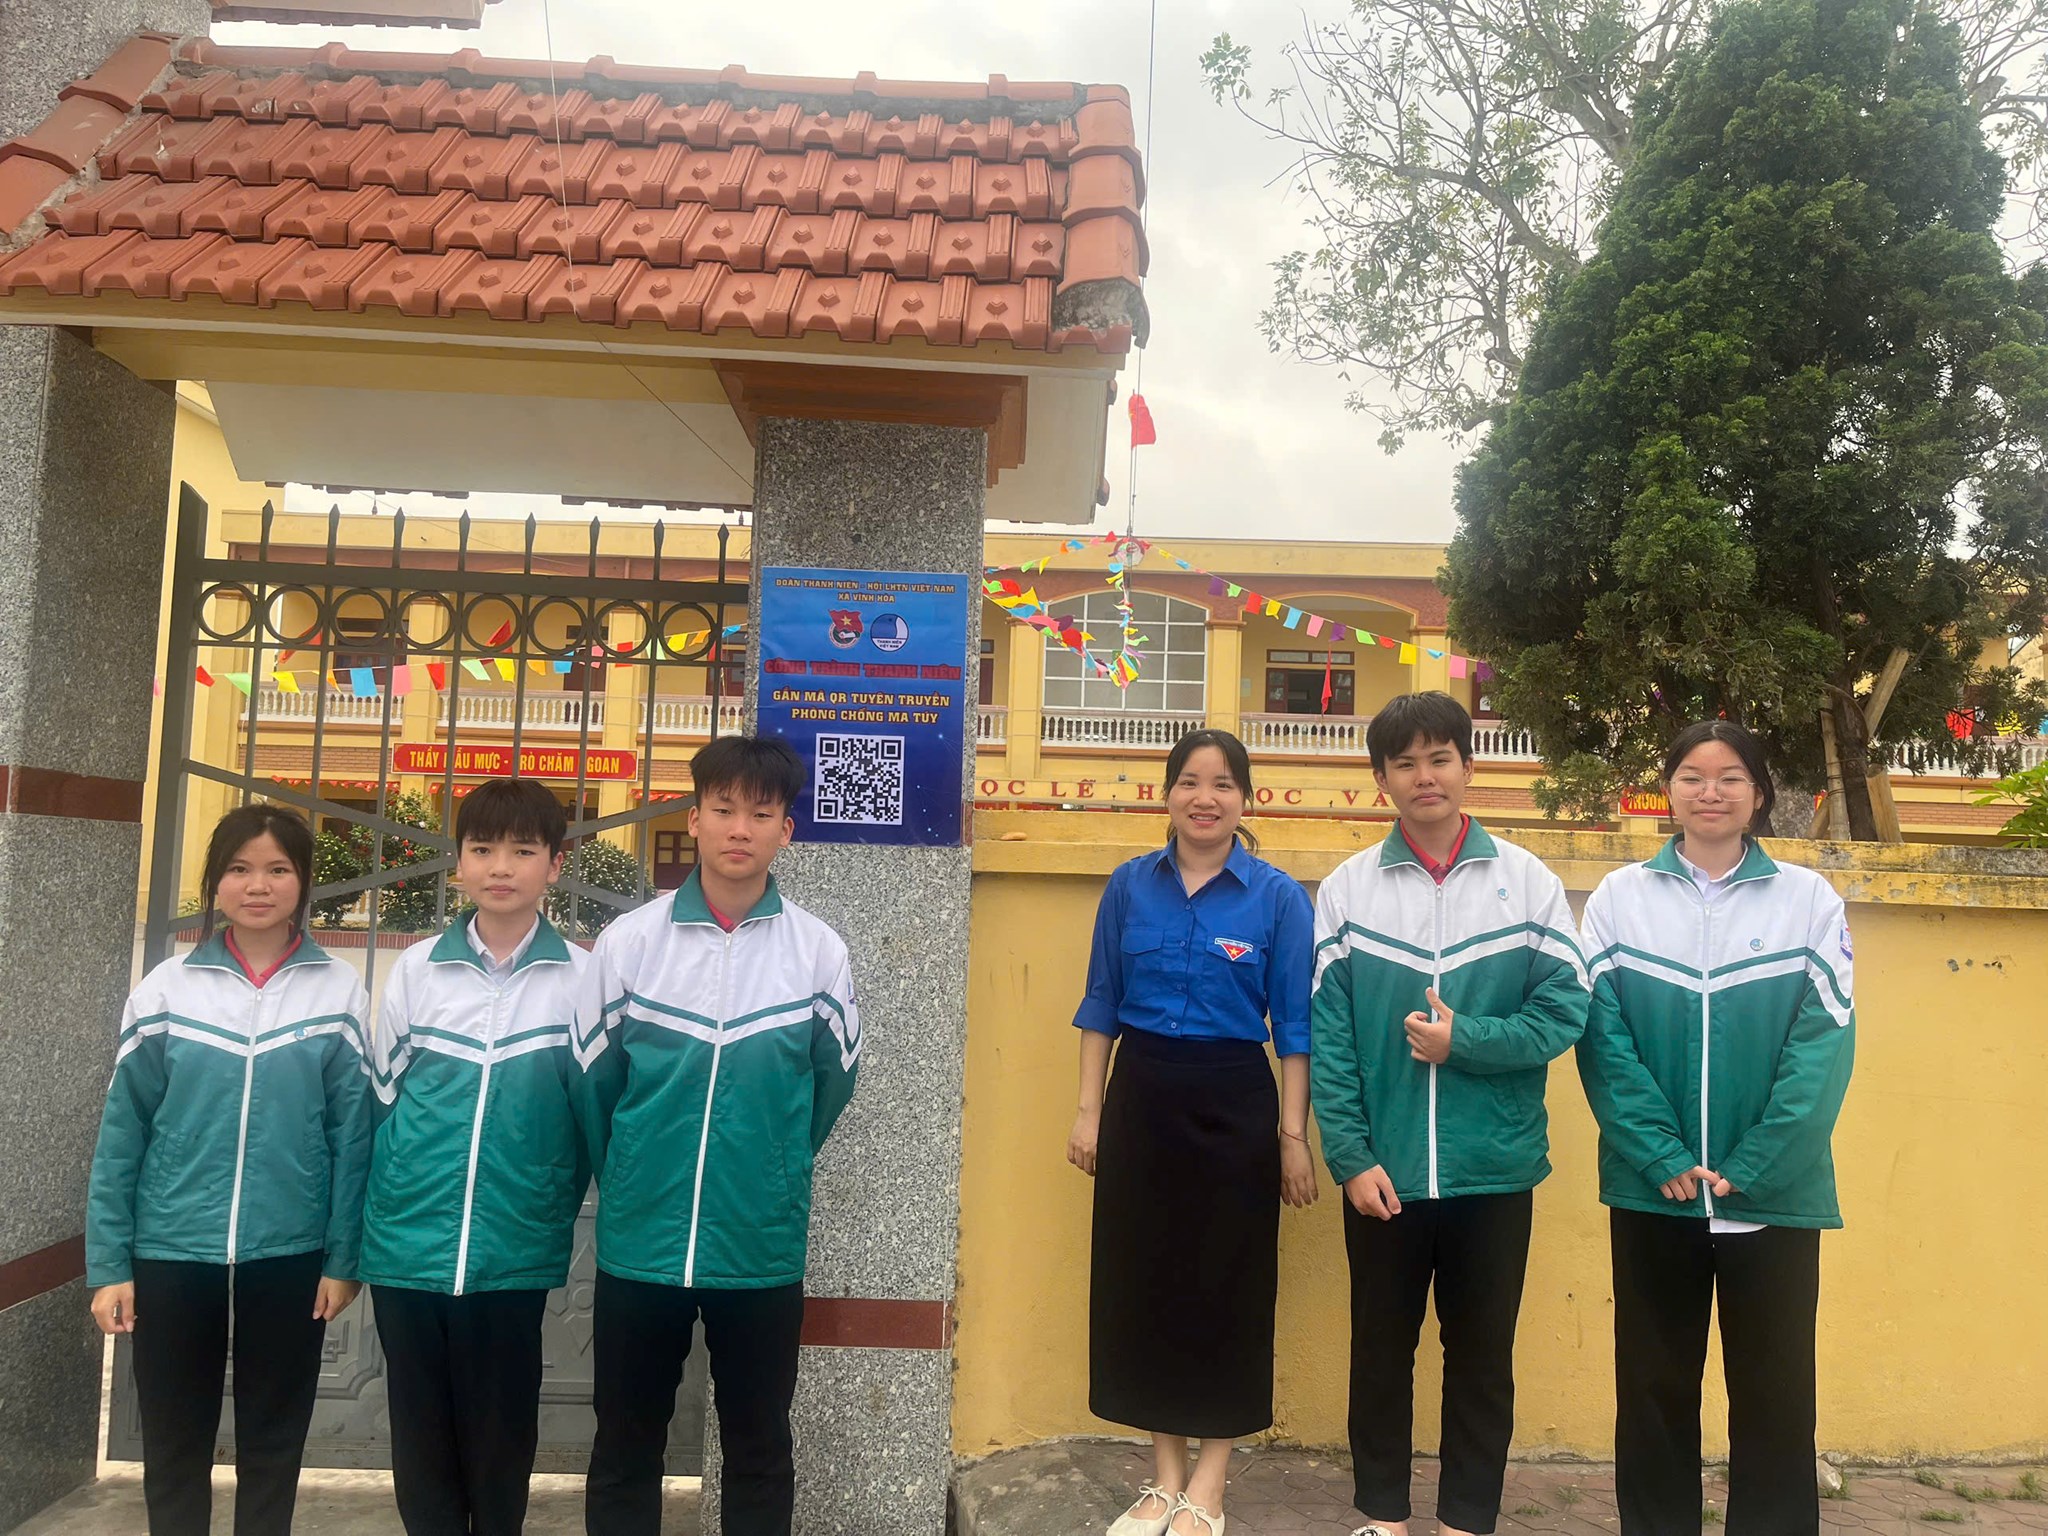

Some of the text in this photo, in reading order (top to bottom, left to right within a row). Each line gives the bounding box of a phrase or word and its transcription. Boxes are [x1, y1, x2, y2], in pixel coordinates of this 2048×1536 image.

[803, 579, 834, 588] THANH
[867, 581, 883, 592] HỘI
[885, 583, 909, 592] LHTN
[911, 583, 931, 593] VIỆT
[933, 584, 955, 593] NAM
[764, 657, 961, 680] CÔNG TRÌNH THANH NIÊN
[772, 685, 950, 707] GẮN MÃ QR TUYÊN TRUYỀN
[791, 706, 938, 724] PHÒNG CHỐNG MA TÚY
[474, 752, 500, 773] MỰC
[519, 751, 535, 771] RÒ
[539, 752, 574, 772] CHĂM
[586, 756, 619, 773] GOAN
[981, 779, 1025, 796] ỌC
[1255, 787, 1302, 805] ỌC
